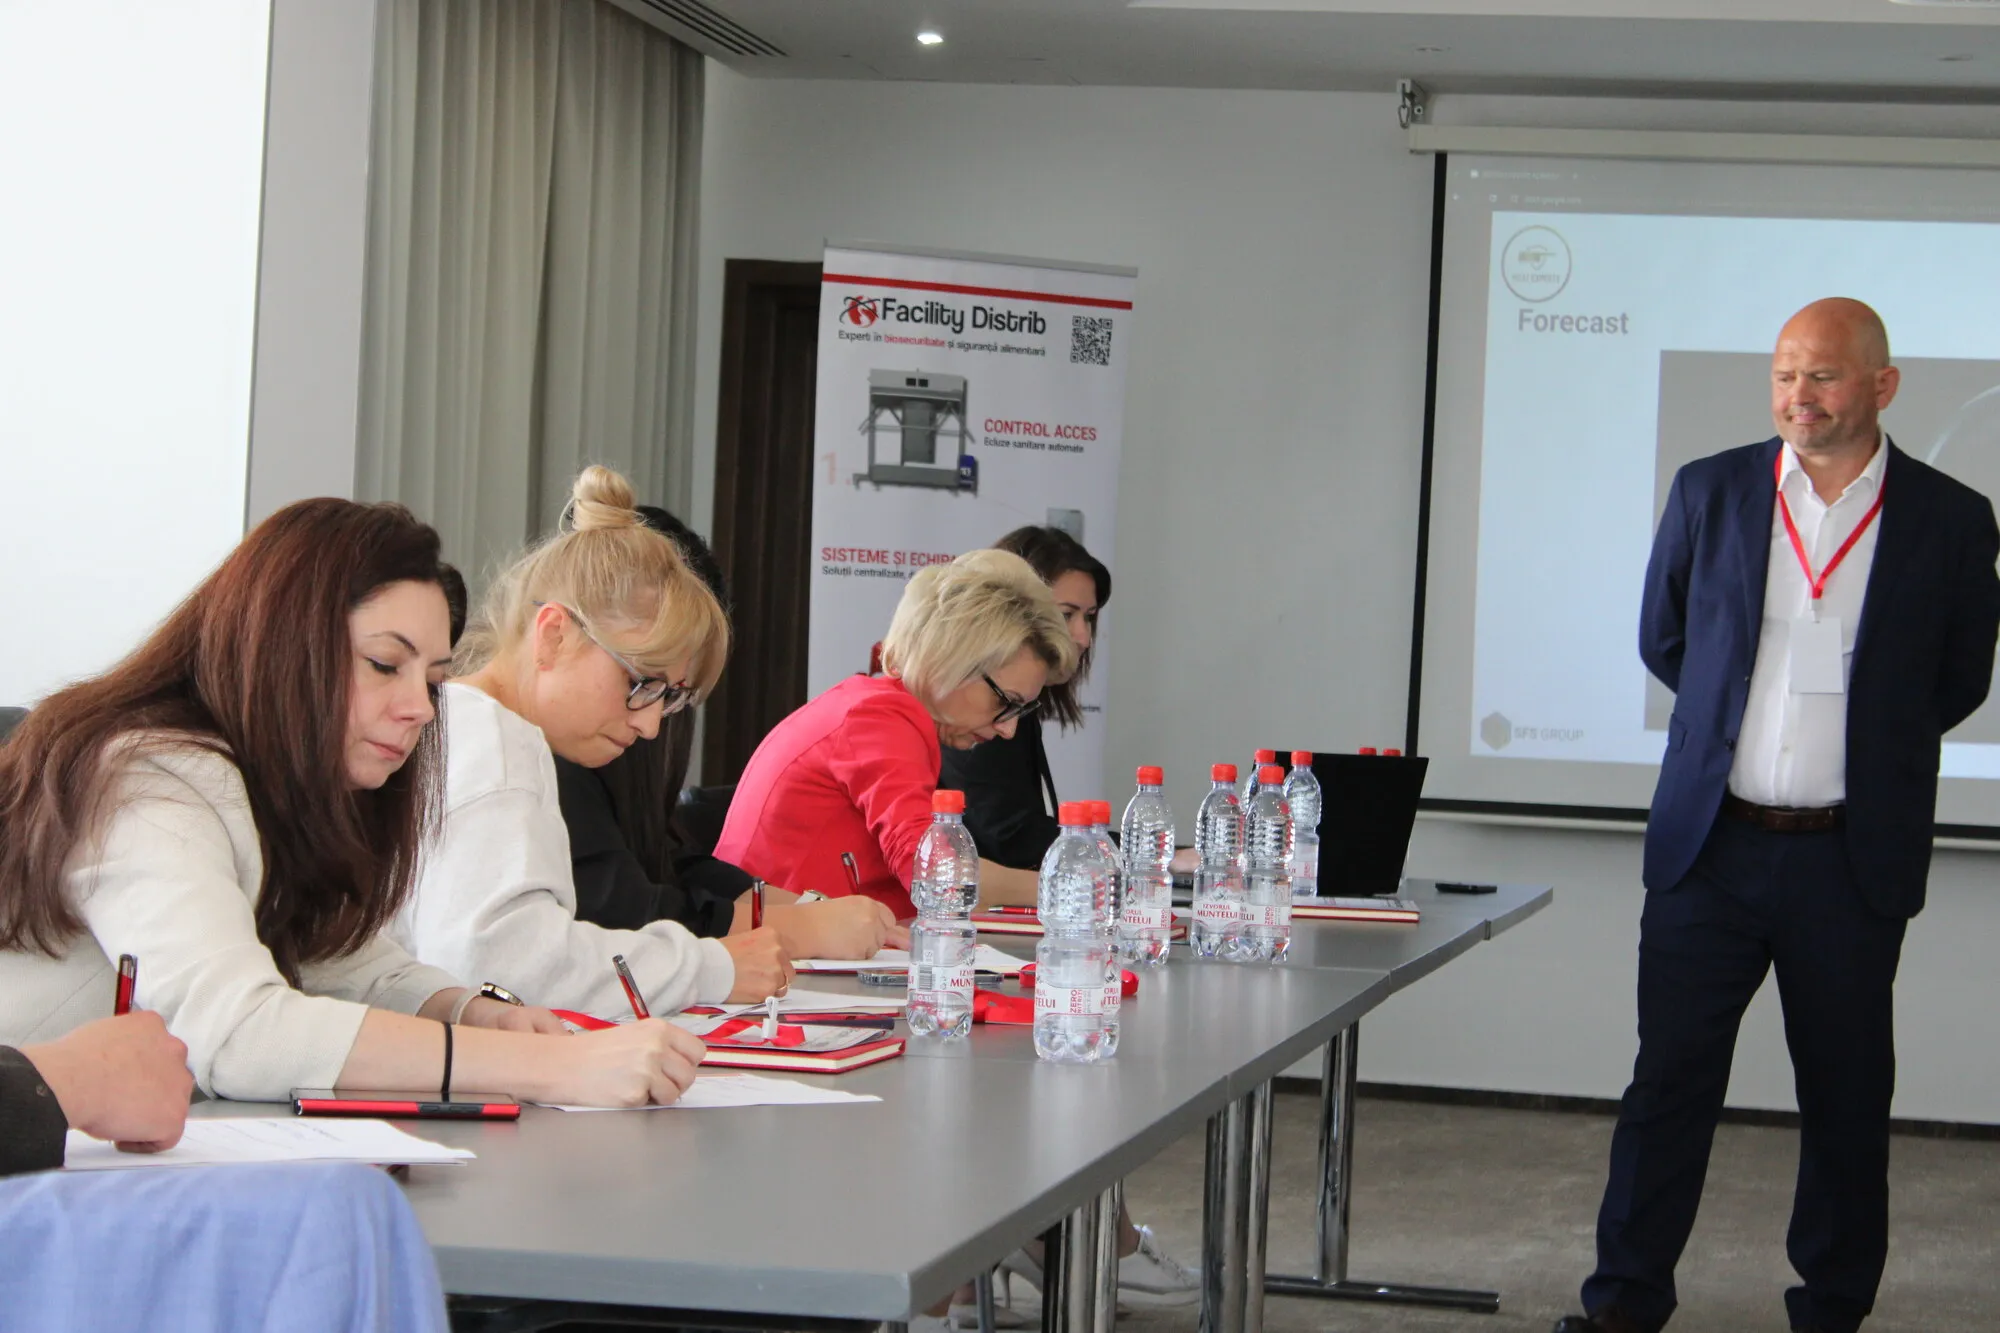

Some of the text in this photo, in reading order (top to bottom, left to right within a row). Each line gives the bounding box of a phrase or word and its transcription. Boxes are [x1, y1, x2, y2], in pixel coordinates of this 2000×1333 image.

[882, 298, 1046, 334] Facility Distrib
[1518, 308, 1629, 334] Forecast
[984, 418, 1097, 441] CONTROL ACCES
[983, 436, 1084, 453] Ecluze sanitare automate
[821, 547, 889, 565] SISTEME
[1197, 909, 1239, 919] MUNTELUI
[1070, 989, 1078, 1013] ZERO
